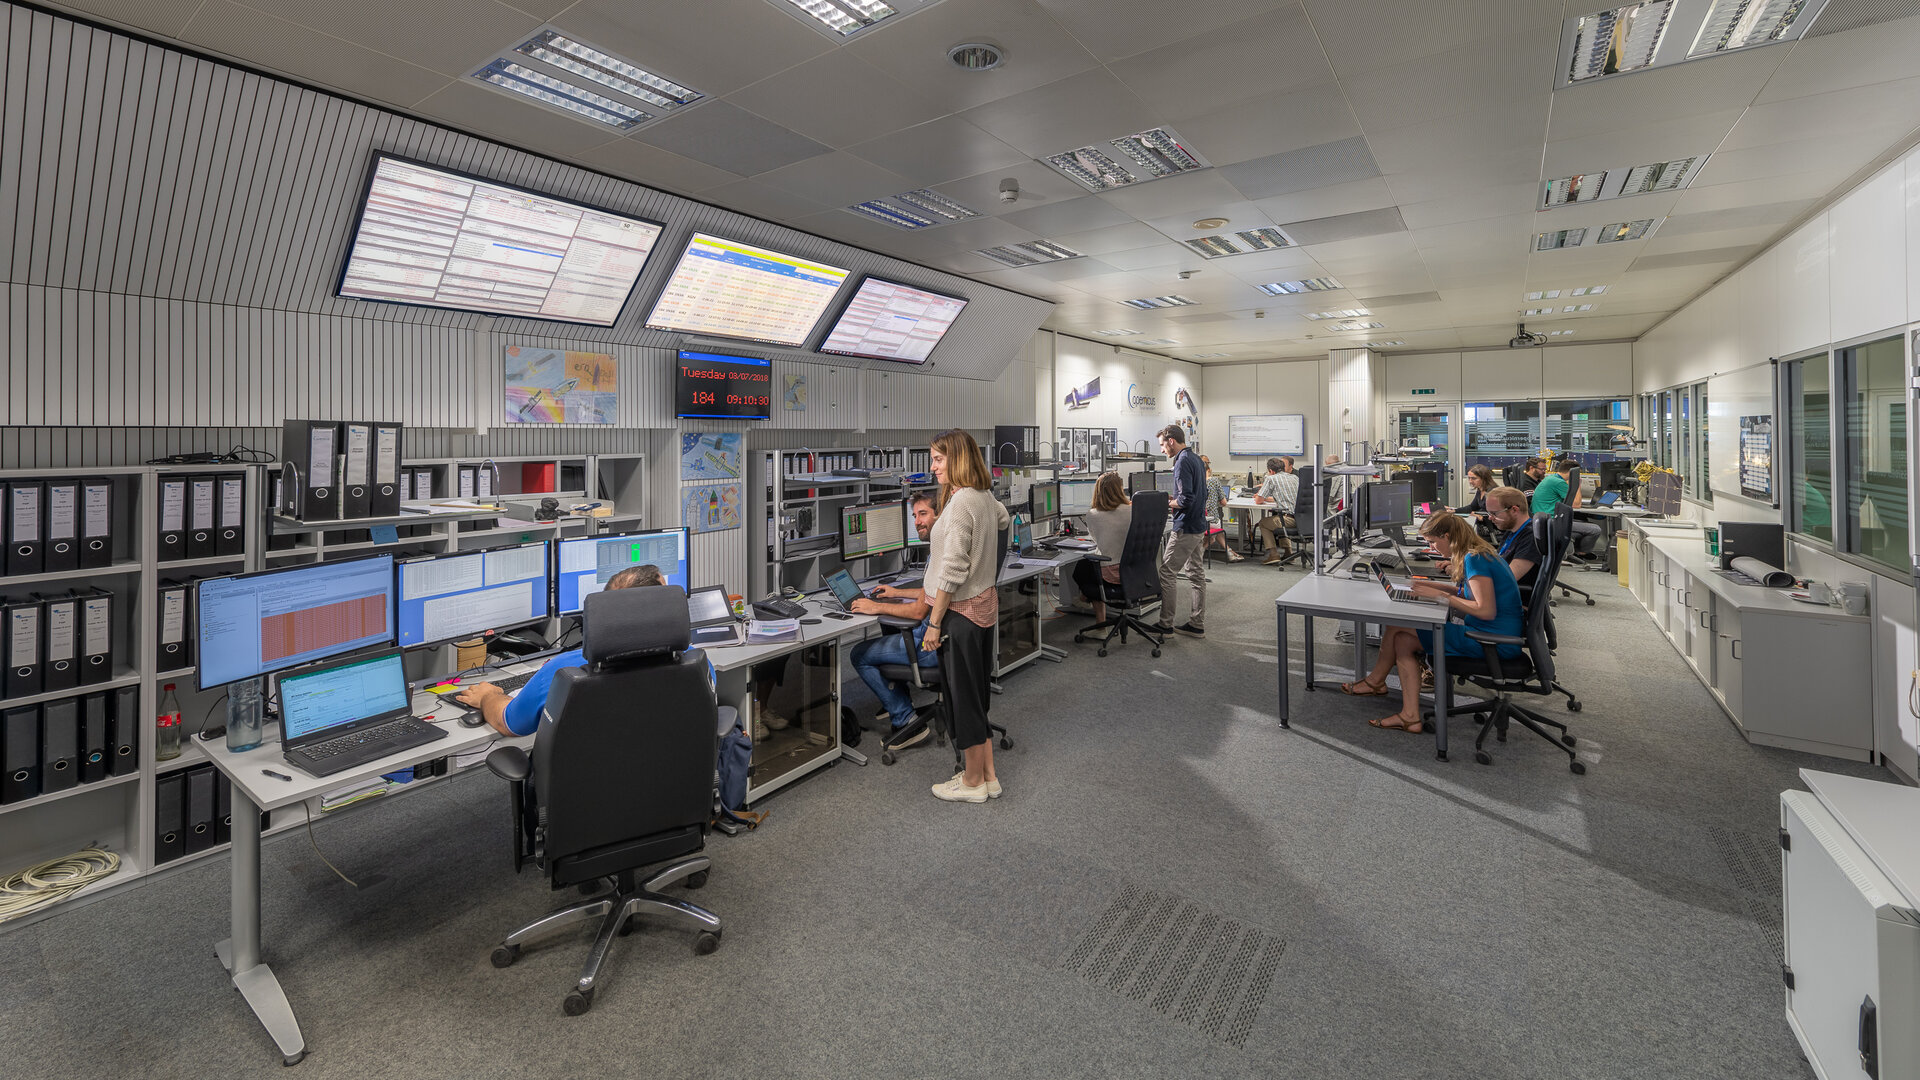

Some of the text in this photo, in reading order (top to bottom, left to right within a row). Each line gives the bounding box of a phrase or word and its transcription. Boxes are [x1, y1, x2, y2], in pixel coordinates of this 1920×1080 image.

[682, 367, 769, 382] Tuesday 03/07/2018
[692, 391, 769, 406] 184 09:10:30
[1128, 384, 1155, 408] Copernicus
